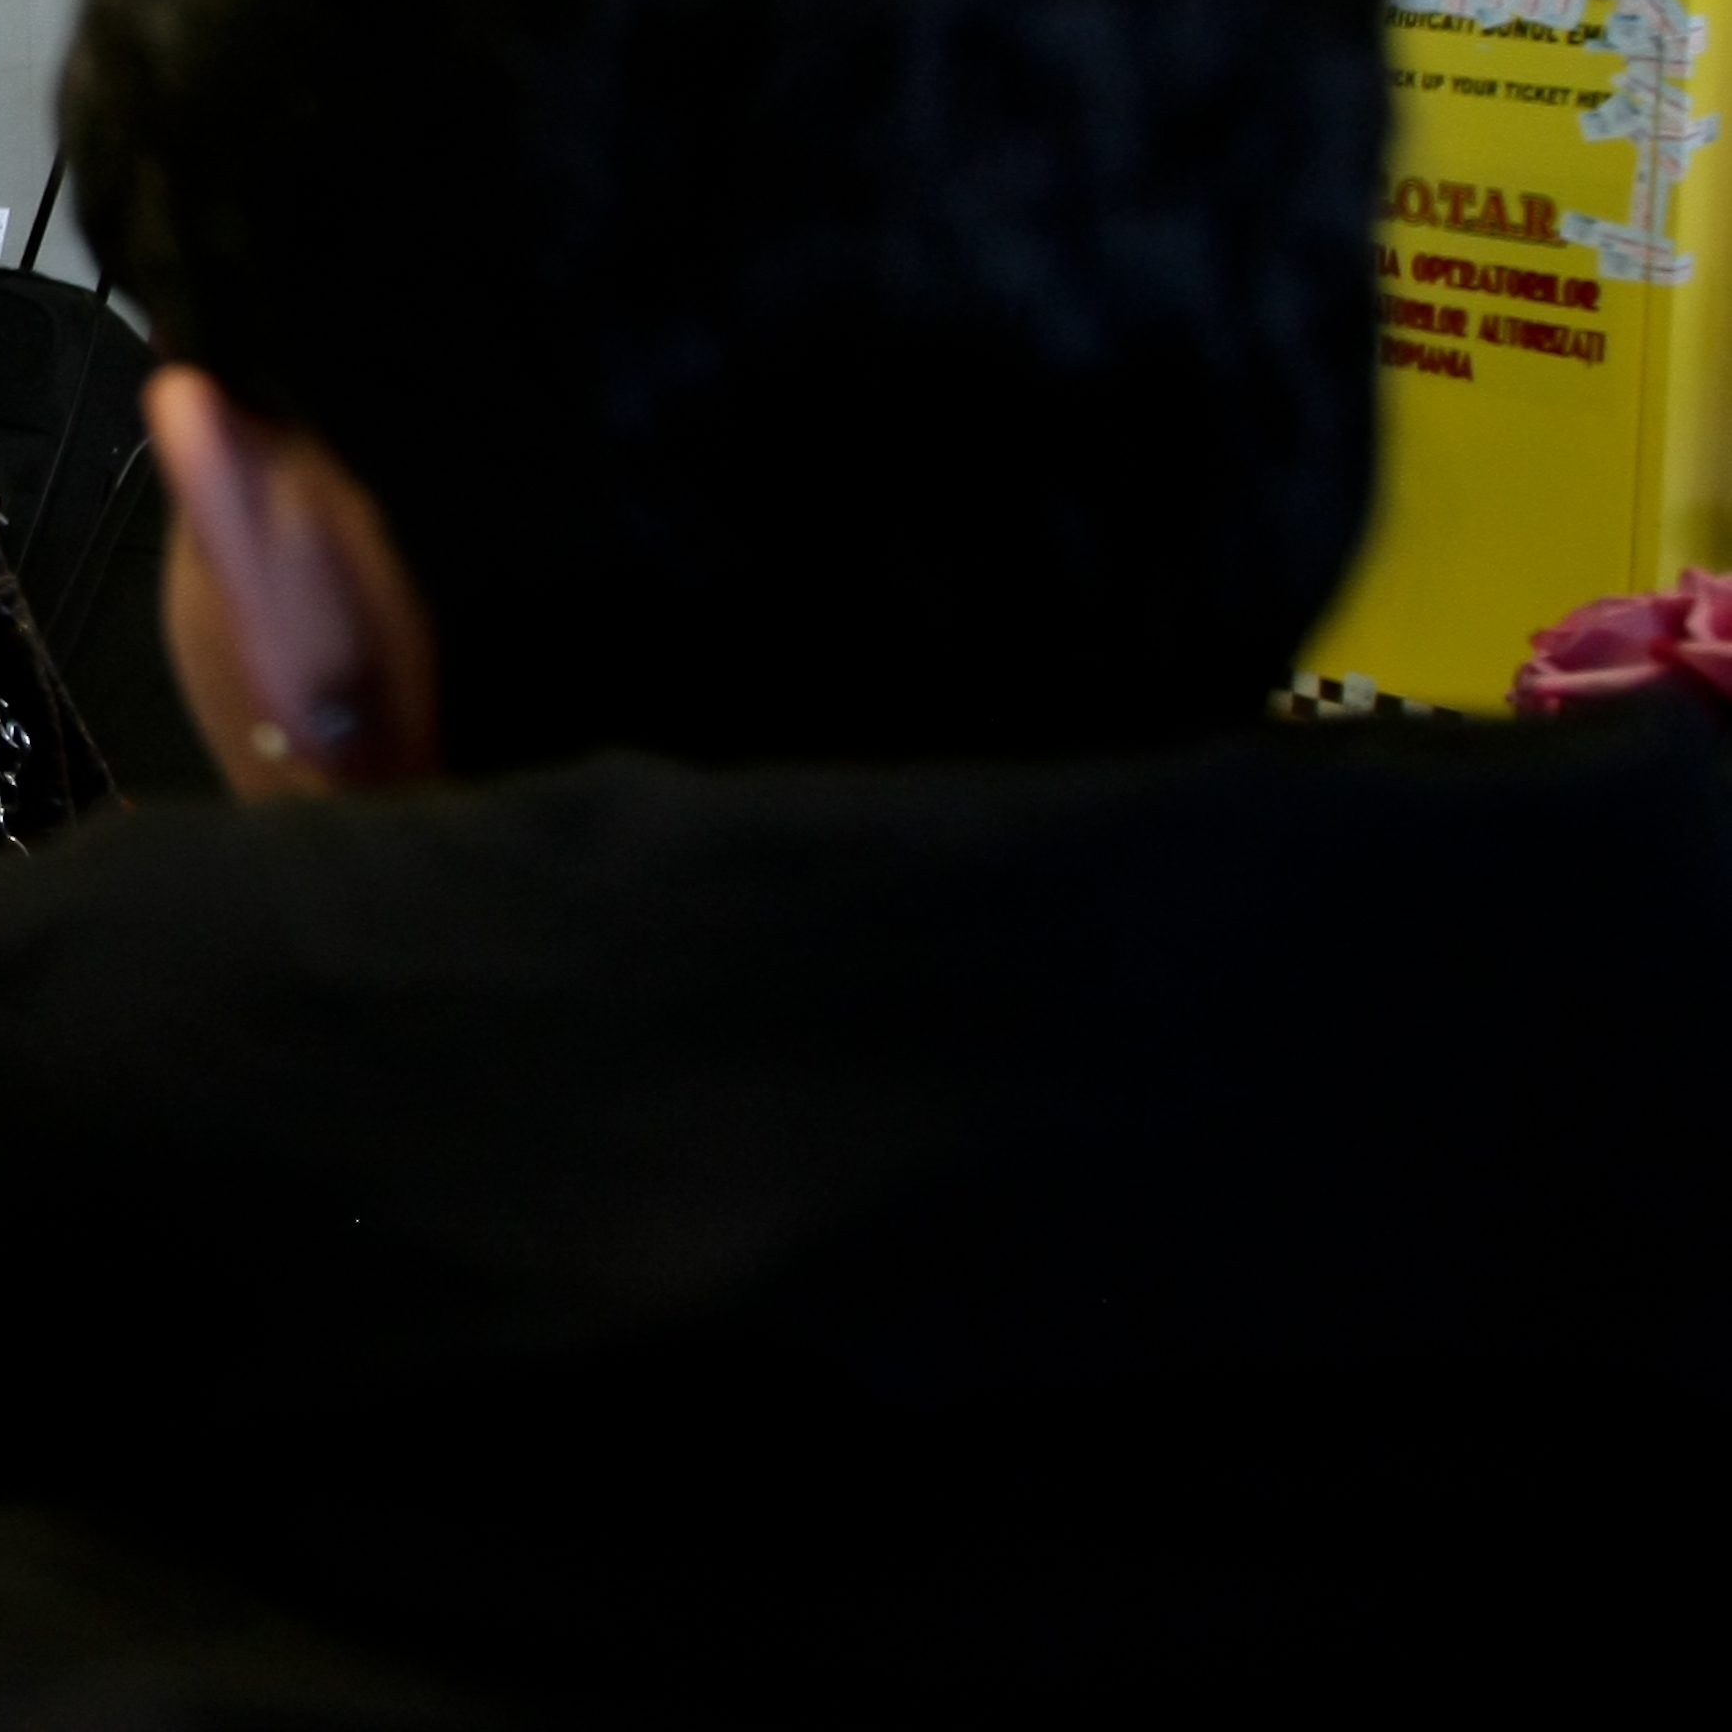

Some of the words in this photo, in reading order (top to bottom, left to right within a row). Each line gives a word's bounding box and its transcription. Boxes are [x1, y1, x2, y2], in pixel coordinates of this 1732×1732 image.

[1421, 72, 1445, 90] UP
[1451, 76, 1498, 96] YOUR
[1505, 82, 1572, 107] TICKET
